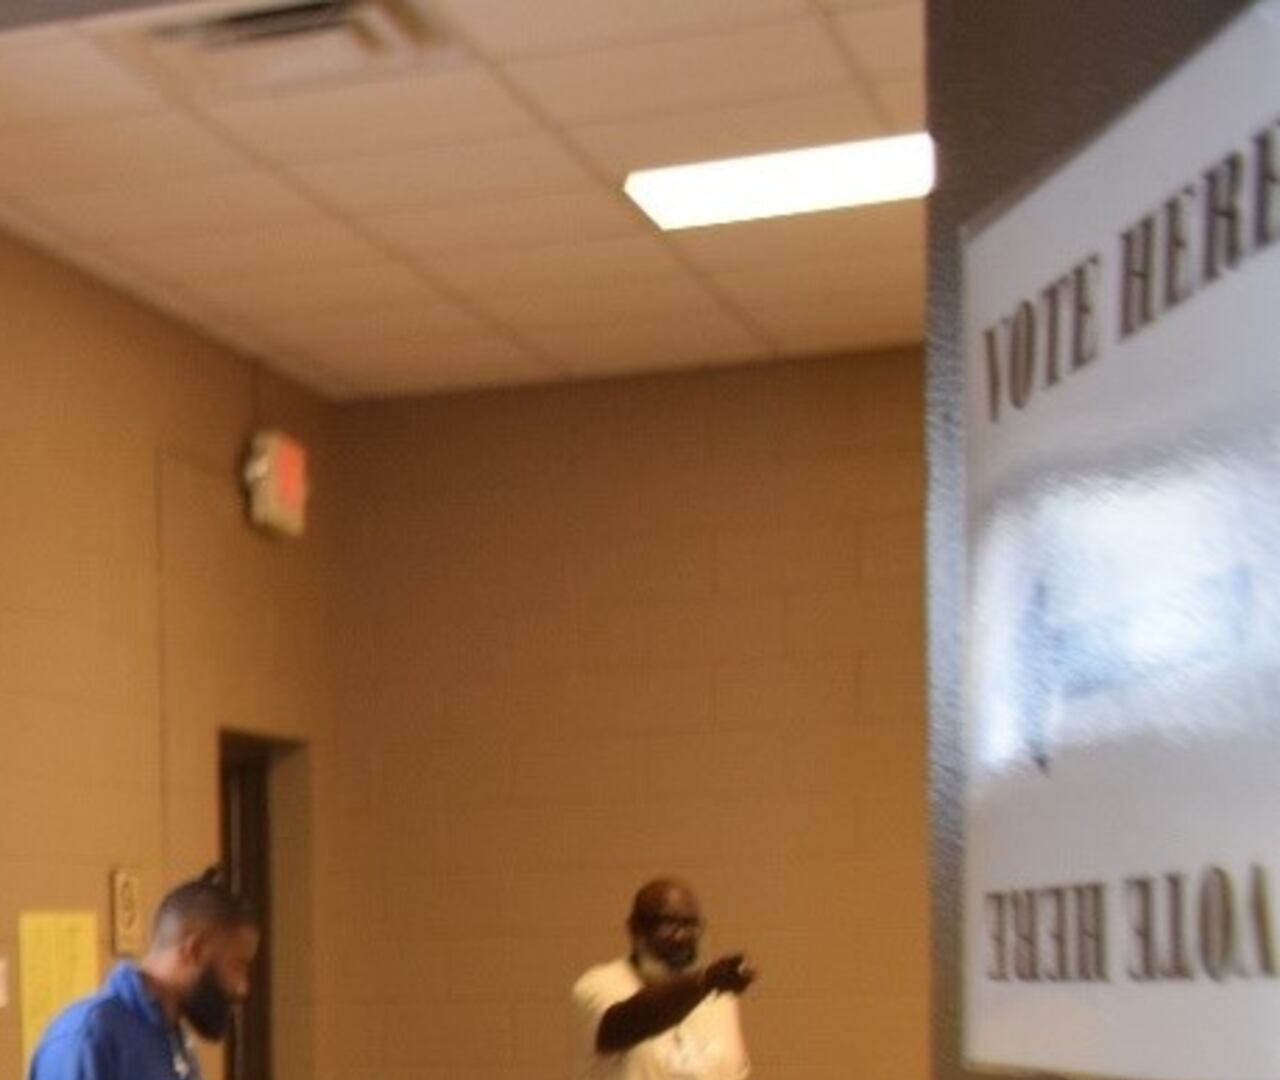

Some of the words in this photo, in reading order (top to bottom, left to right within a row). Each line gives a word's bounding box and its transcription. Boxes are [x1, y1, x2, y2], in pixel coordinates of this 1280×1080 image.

[984, 252, 1102, 427] VOTE
[1116, 118, 1280, 344] HERE
[984, 881, 1111, 983] HERE
